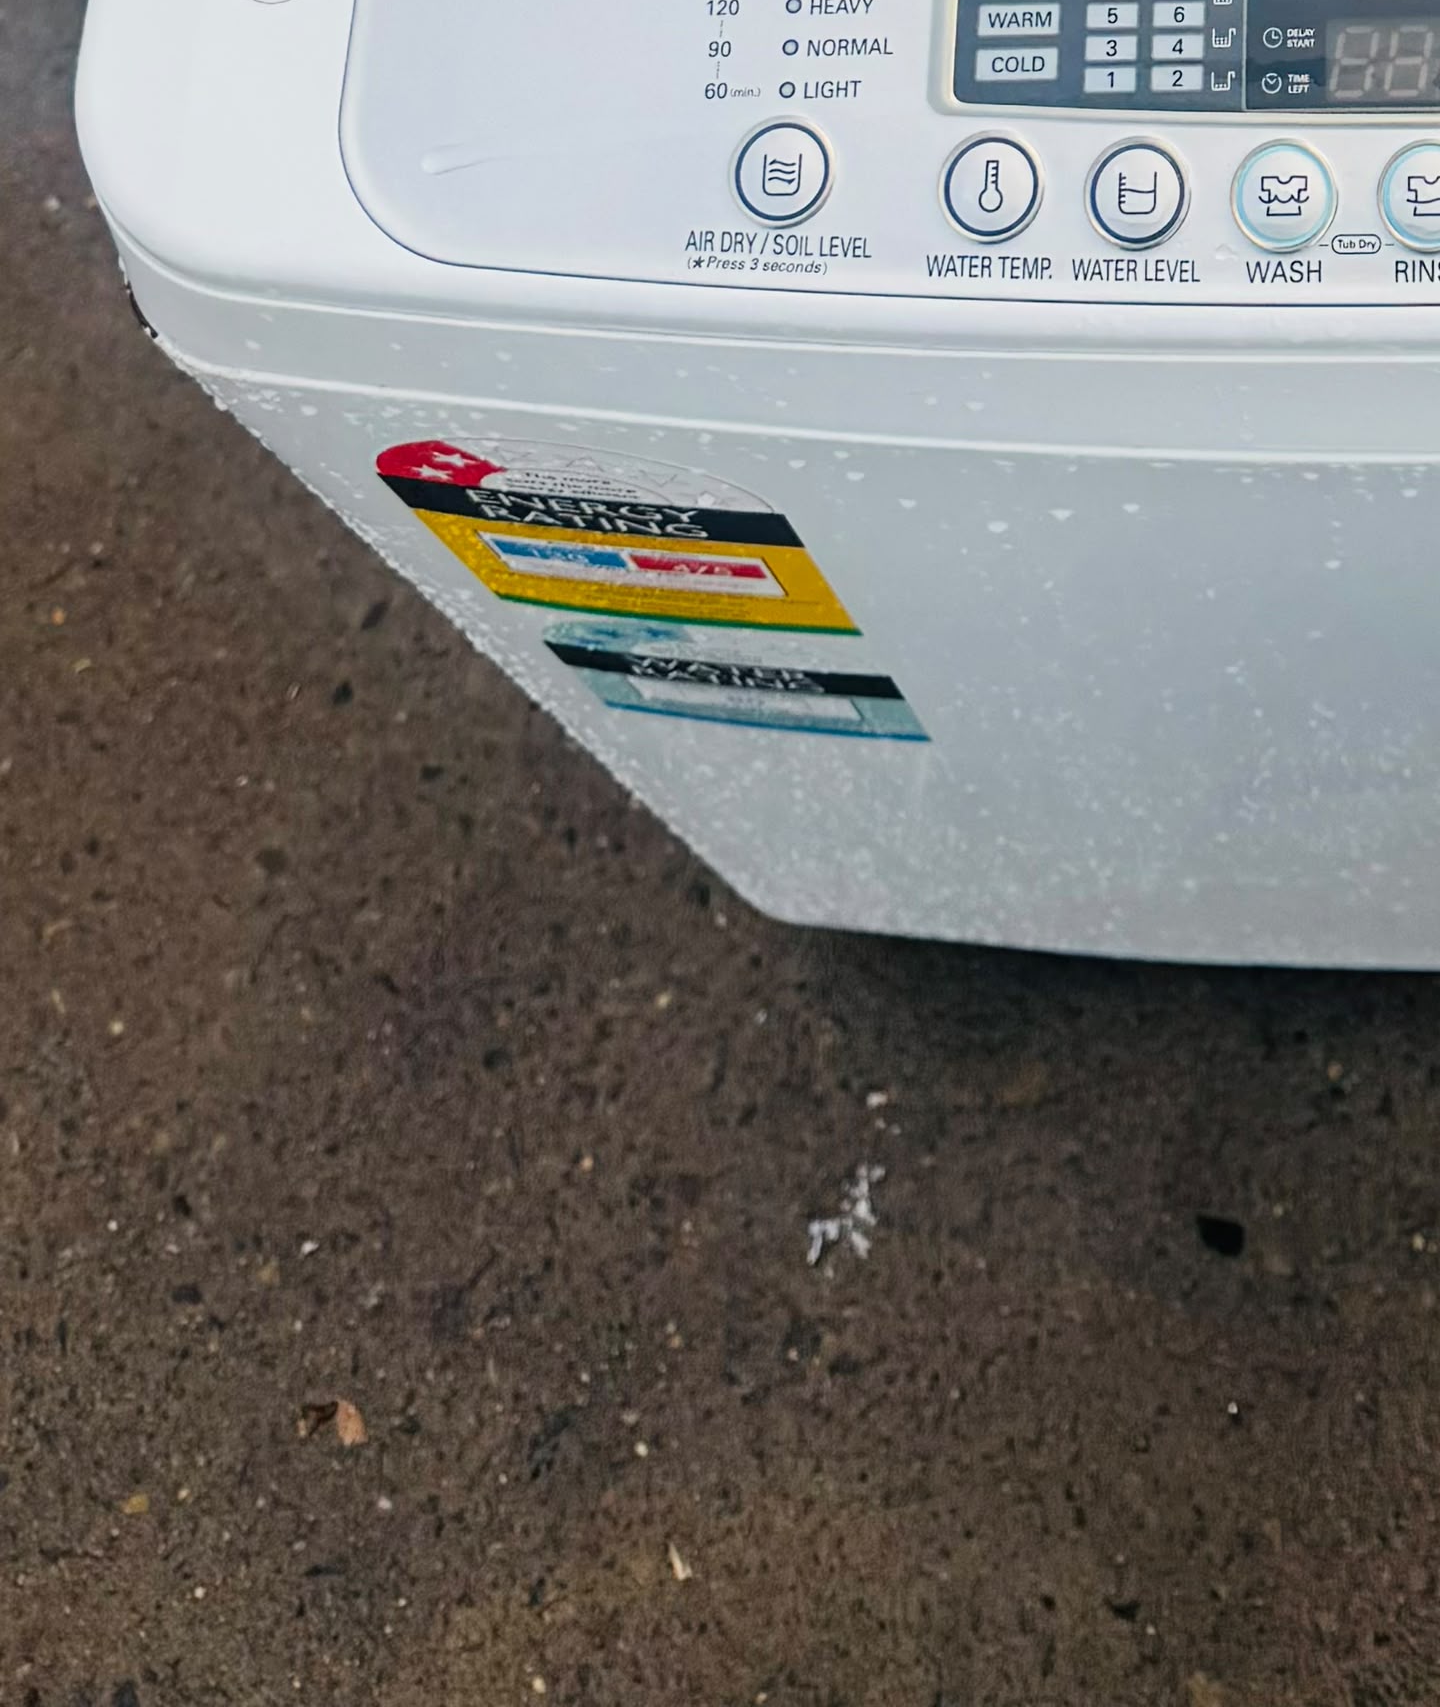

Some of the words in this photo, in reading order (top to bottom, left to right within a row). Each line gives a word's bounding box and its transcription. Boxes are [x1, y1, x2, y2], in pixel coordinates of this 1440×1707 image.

[707, 0, 740, 16] 120
[1107, 7, 1118, 24] 5
[1173, 5, 1185, 23] 6
[988, 11, 1052, 28] WARM
[708, 40, 732, 58] 90
[806, 37, 894, 56] NORMAL
[1105, 39, 1117, 57] 3
[1171, 37, 1184, 55] 4
[991, 55, 1045, 73] COLD
[1106, 71, 1115, 88] 1
[1171, 69, 1183, 87] 2
[704, 82, 728, 100] 60
[730, 87, 761, 98] (min.)
[804, 80, 862, 99] LIGHT
[685, 230, 715, 252] AIR
[720, 231, 758, 254] DRY
[773, 234, 813, 256] SOIL
[819, 236, 872, 259] LEVEL
[1338, 239, 1355, 250] Tub
[1358, 238, 1378, 251] Dry
[750, 258, 759, 271] 3
[763, 260, 828, 275] seconds)
[926, 254, 992, 278] WATER
[998, 256, 1053, 279] TEMP.
[1072, 258, 1138, 282] WATER
[1144, 259, 1201, 283] LEVEL
[1246, 259, 1322, 283] WASH
[466, 488, 699, 523] ENERGY
[480, 503, 709, 538] RATING
